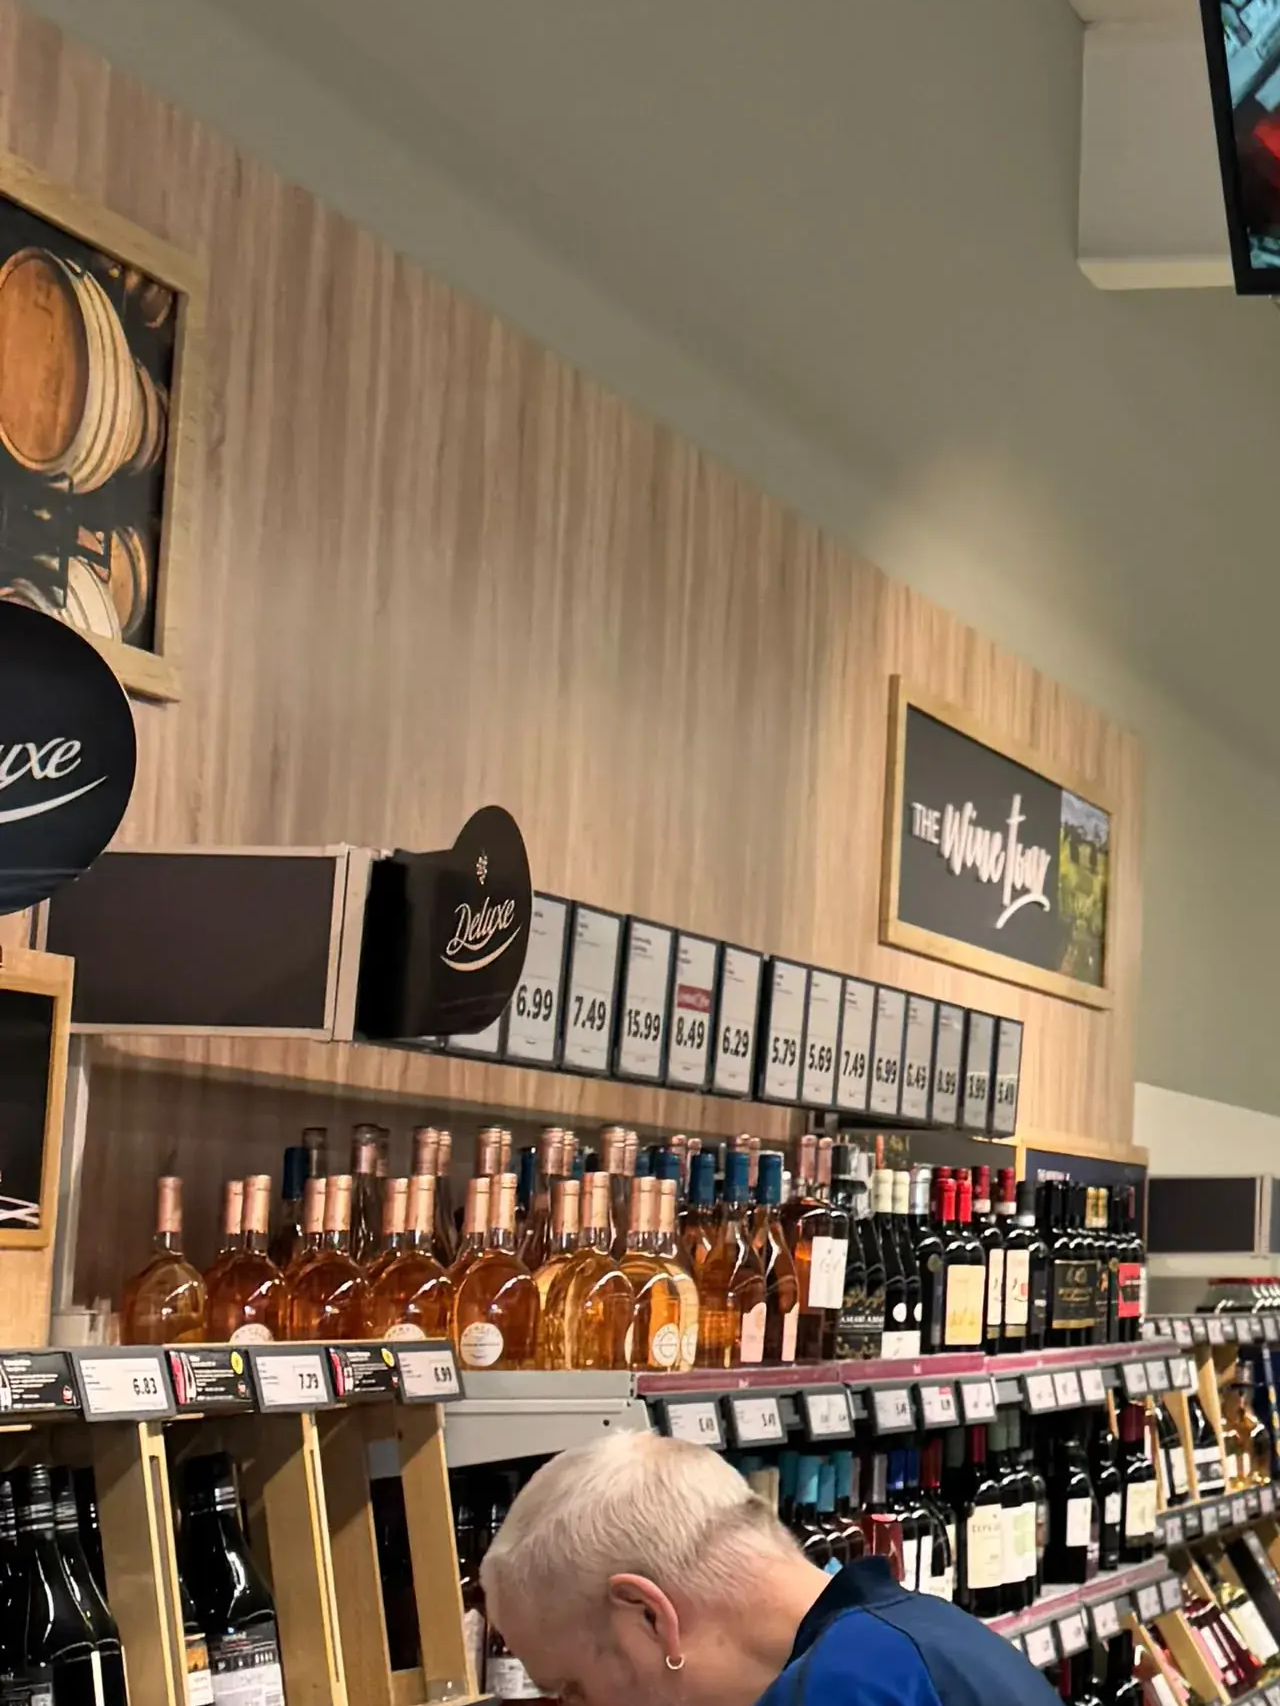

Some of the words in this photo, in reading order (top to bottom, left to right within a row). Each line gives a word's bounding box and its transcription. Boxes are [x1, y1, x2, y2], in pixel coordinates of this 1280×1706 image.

[911, 801, 942, 845] THE
[940, 801, 1005, 884] Wine
[447, 893, 518, 954] Deluxe
[516, 984, 553, 1022] 6.99
[573, 995, 607, 1032] 7.49
[627, 1008, 661, 1042] 15.99
[676, 1016, 705, 1050] 8.49
[722, 1026, 750, 1058] 6.29
[771, 1036, 796, 1067] 5.79
[808, 1044, 833, 1073] 5.69
[843, 1050, 865, 1079] 7.49
